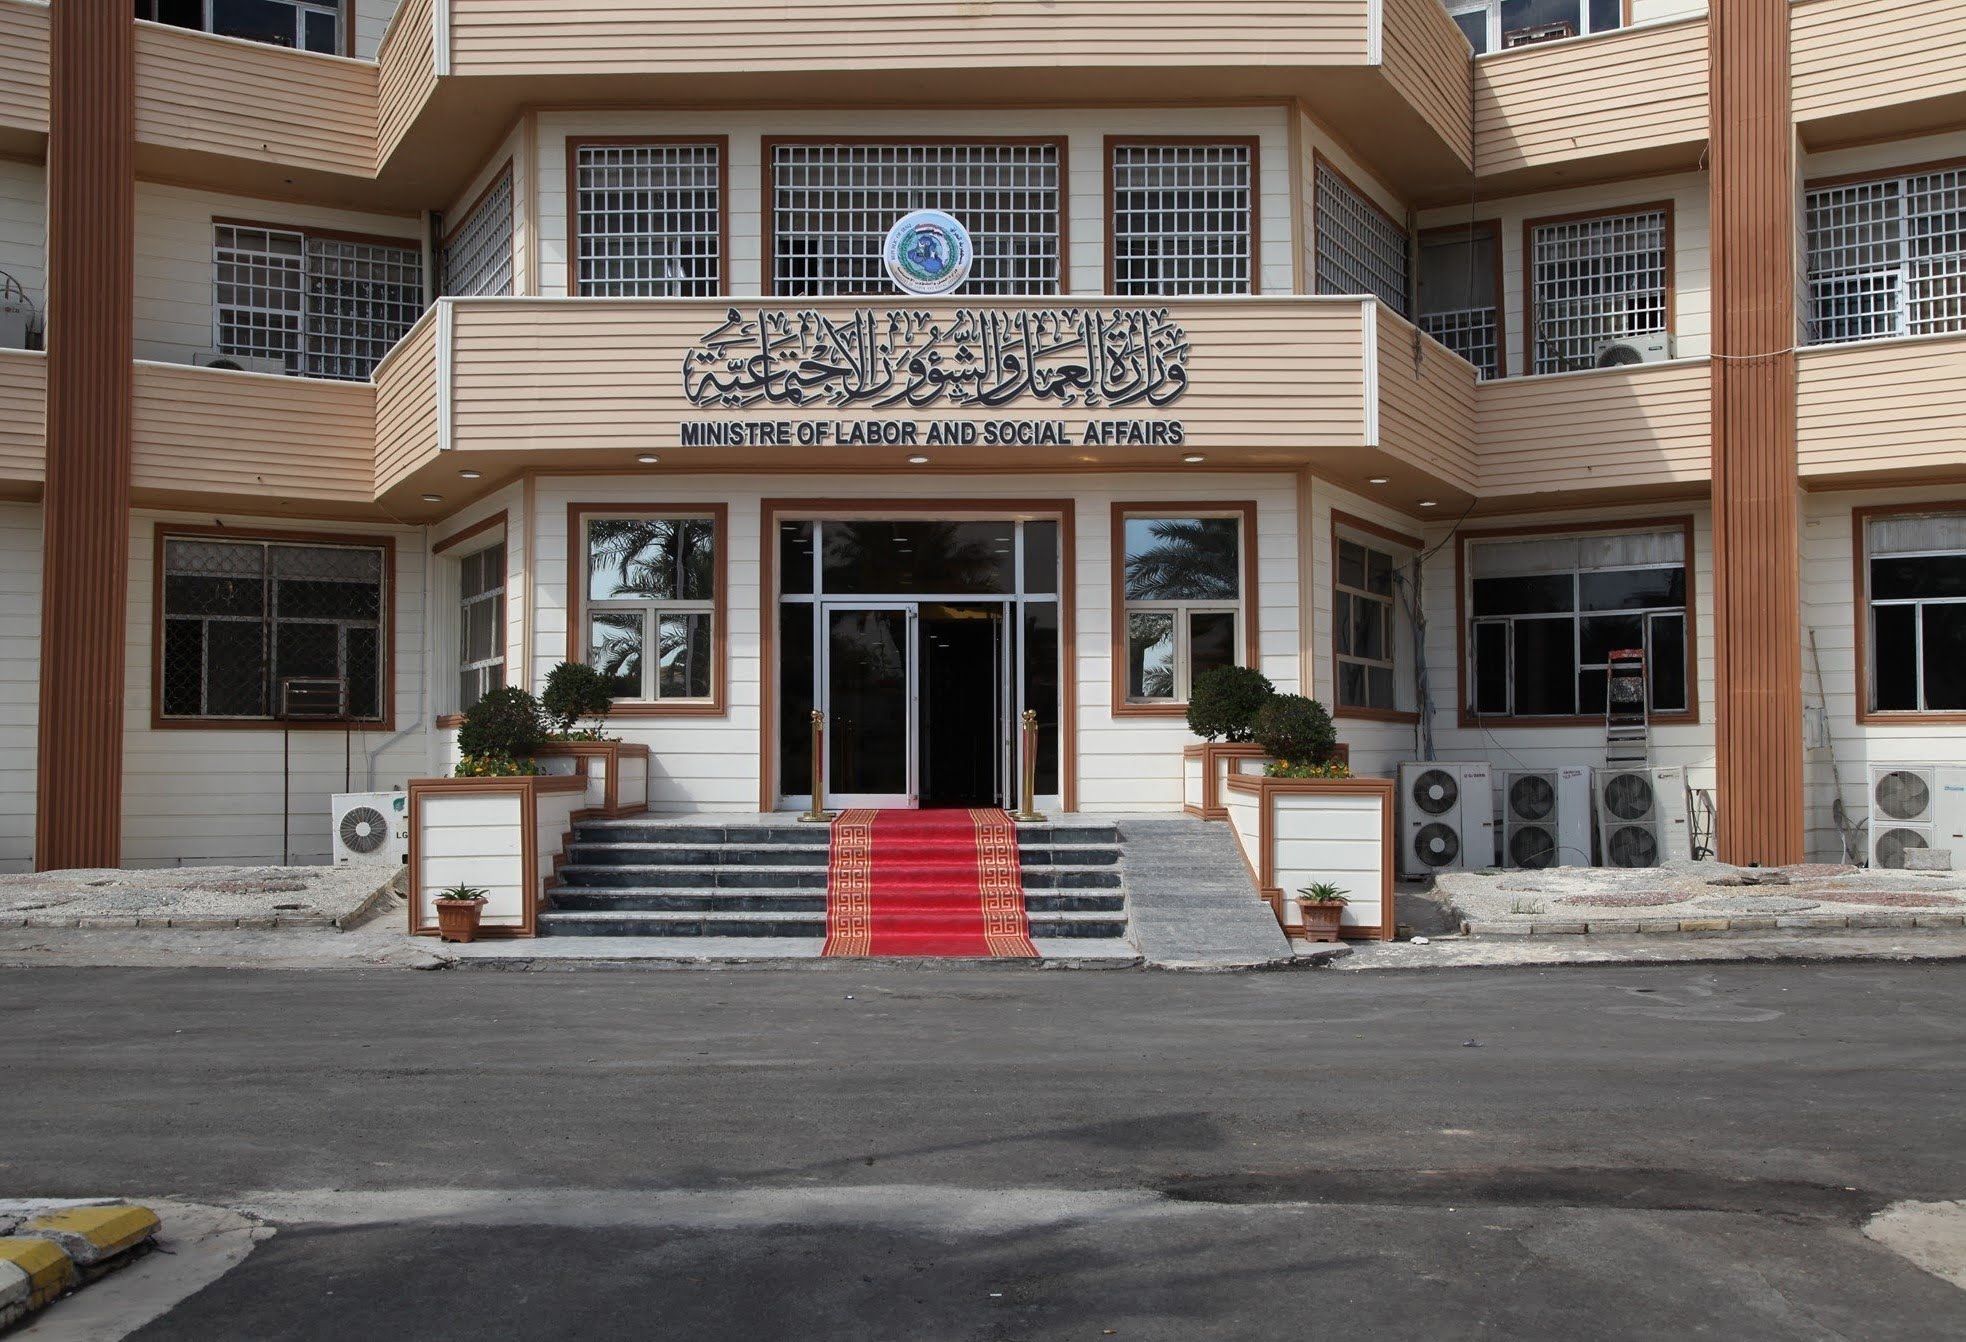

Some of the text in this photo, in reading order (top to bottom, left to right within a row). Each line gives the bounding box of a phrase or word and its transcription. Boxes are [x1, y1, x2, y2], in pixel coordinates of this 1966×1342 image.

[680, 421, 1184, 446] MINISTRE OF LABOR AND SOCIAL AFFAIRS
[396, 831, 408, 839] LG
